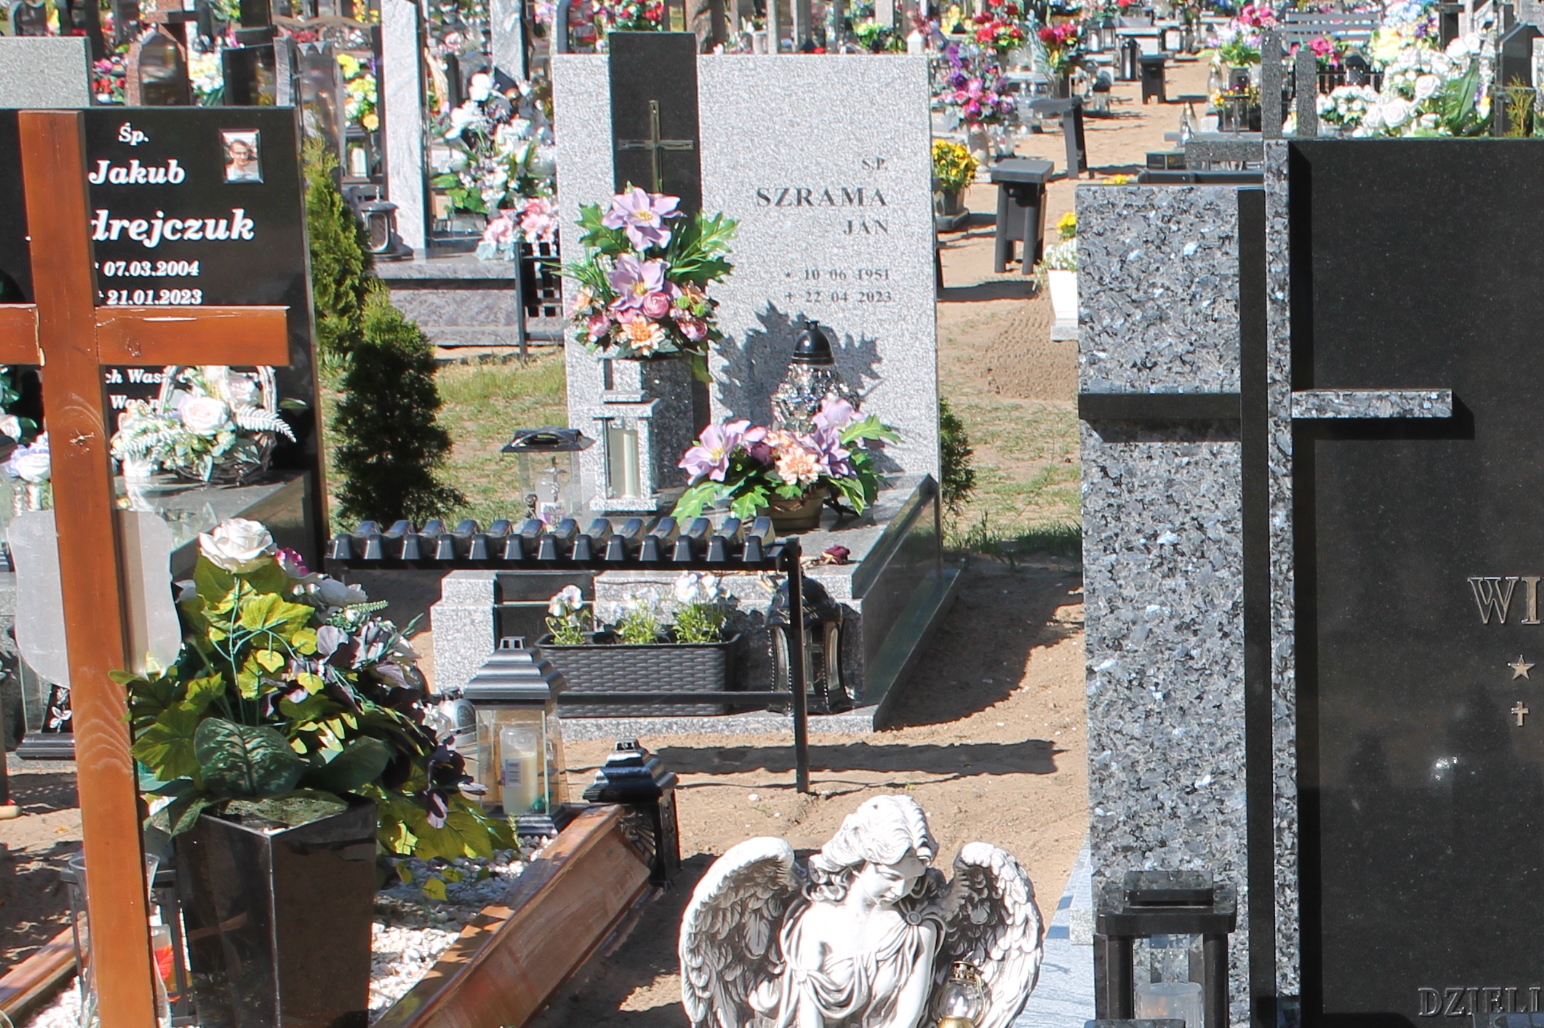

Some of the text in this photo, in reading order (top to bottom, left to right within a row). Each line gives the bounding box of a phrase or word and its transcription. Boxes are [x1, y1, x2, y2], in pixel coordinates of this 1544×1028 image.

[118, 122, 149, 146] Śp.
[88, 159, 186, 185] Jakub
[755, 187, 888, 207] SZRAMA
[843, 219, 890, 236] JAN
[104, 260, 200, 278] 07.03.2004
[106, 288, 202, 306] 21.01.2023
[1418, 986, 1541, 1017] DZIELI
